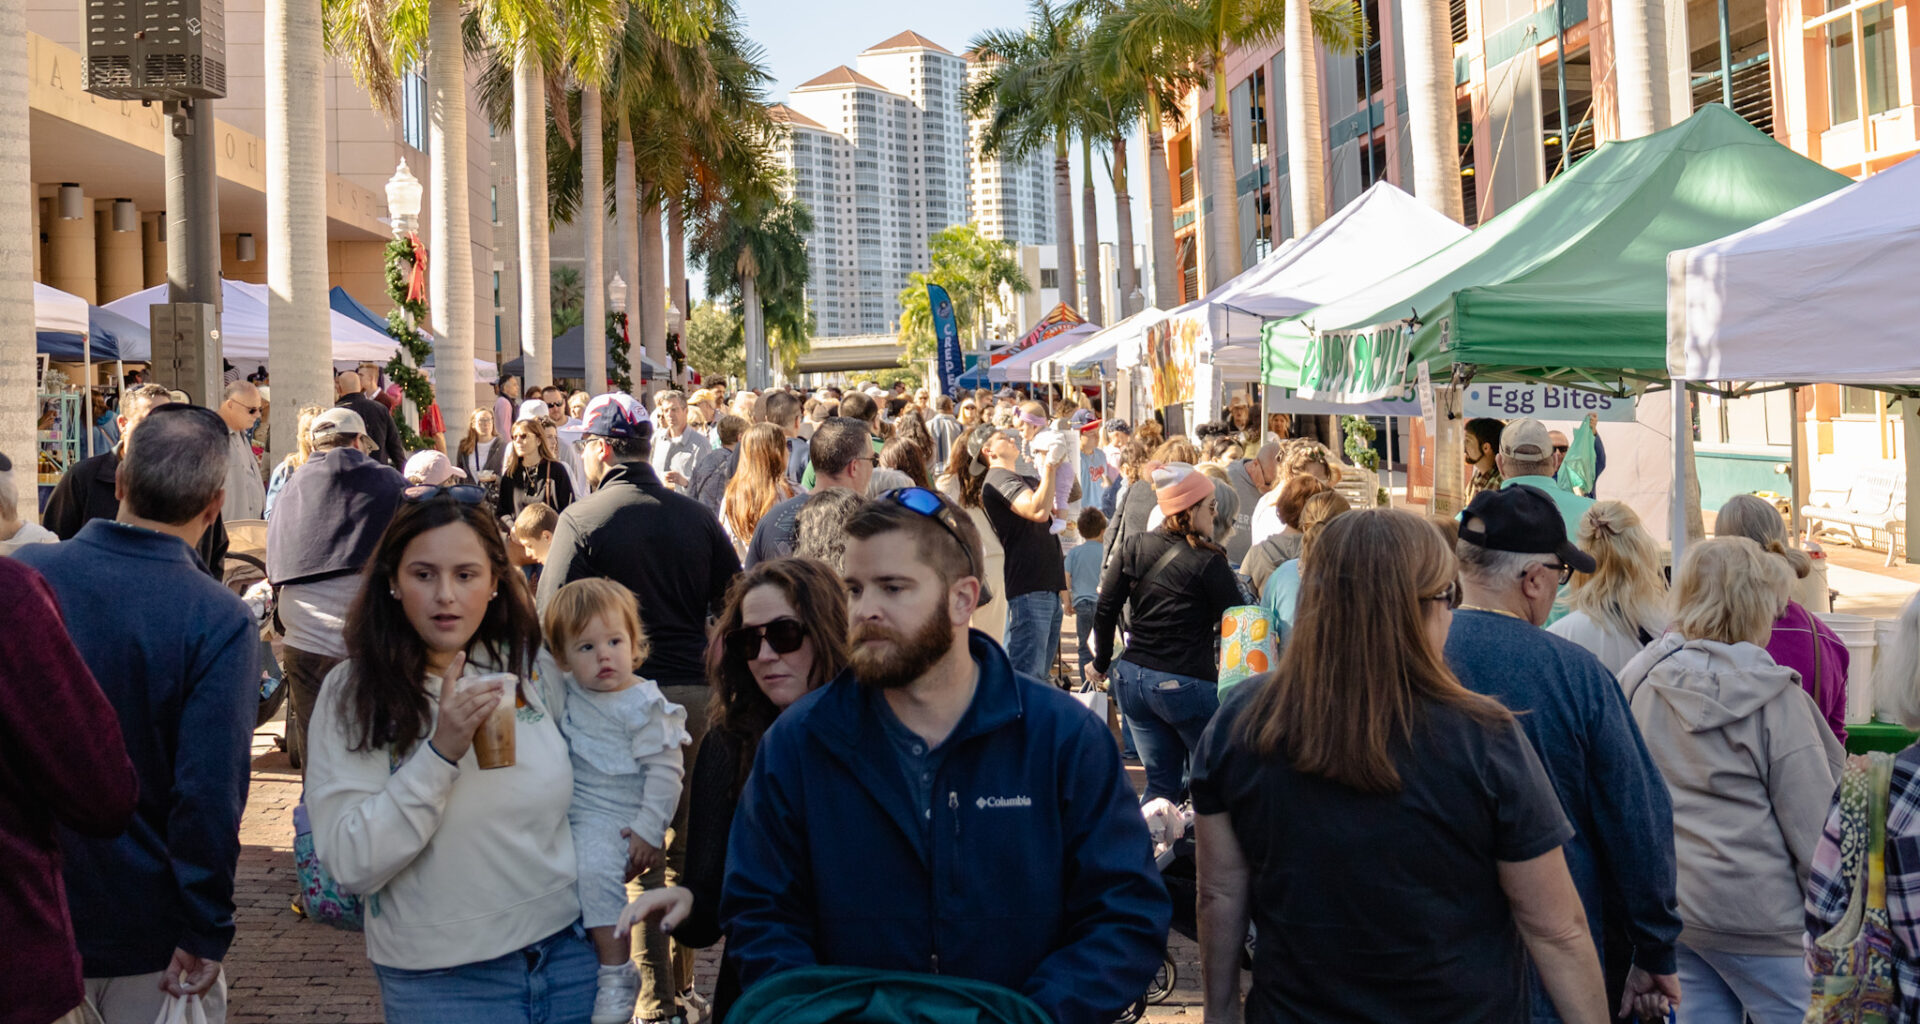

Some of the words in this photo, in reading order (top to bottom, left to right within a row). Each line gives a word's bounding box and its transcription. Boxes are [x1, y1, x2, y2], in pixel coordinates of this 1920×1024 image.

[1488, 385, 1535, 414] Egg
[1544, 386, 1612, 410] Bites
[986, 795, 1032, 808] Columbia
